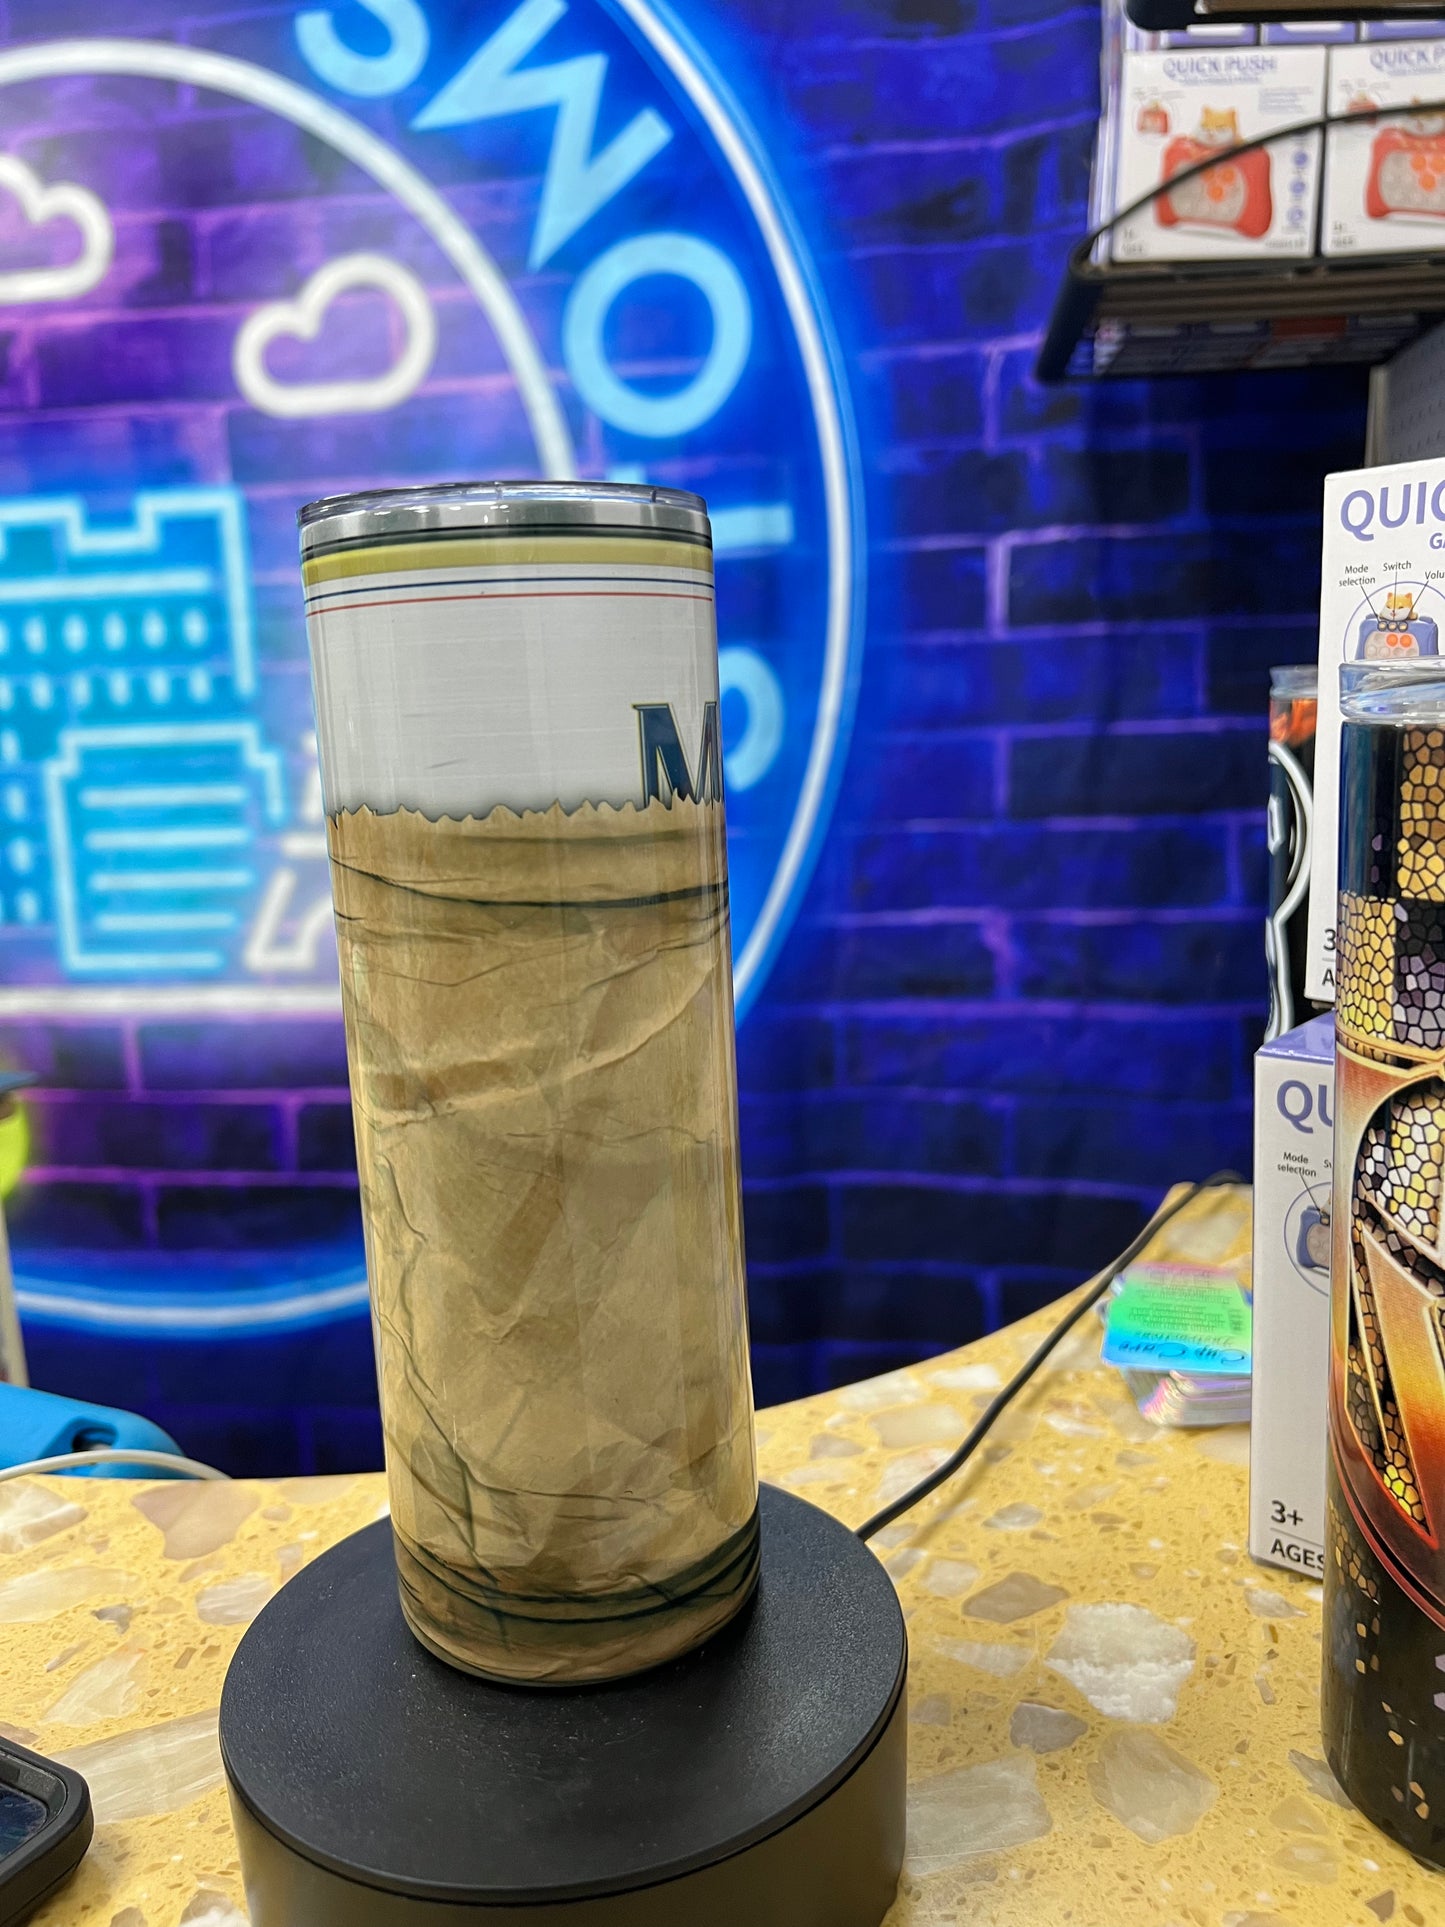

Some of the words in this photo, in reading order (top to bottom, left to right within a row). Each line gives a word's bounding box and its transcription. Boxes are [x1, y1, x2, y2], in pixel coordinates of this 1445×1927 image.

[1369, 47, 1430, 72] QUICK
[1162, 57, 1220, 80] QUICK
[1223, 55, 1277, 72] PUSH
[1345, 564, 1369, 574] Mode
[1383, 560, 1412, 571] Switch
[1339, 576, 1376, 587] selection
[1283, 1152, 1309, 1164] Mode
[1277, 1163, 1317, 1177] selection
[1195, 1345, 1248, 1365] Cup
[1270, 1499, 1303, 1526] 3+
